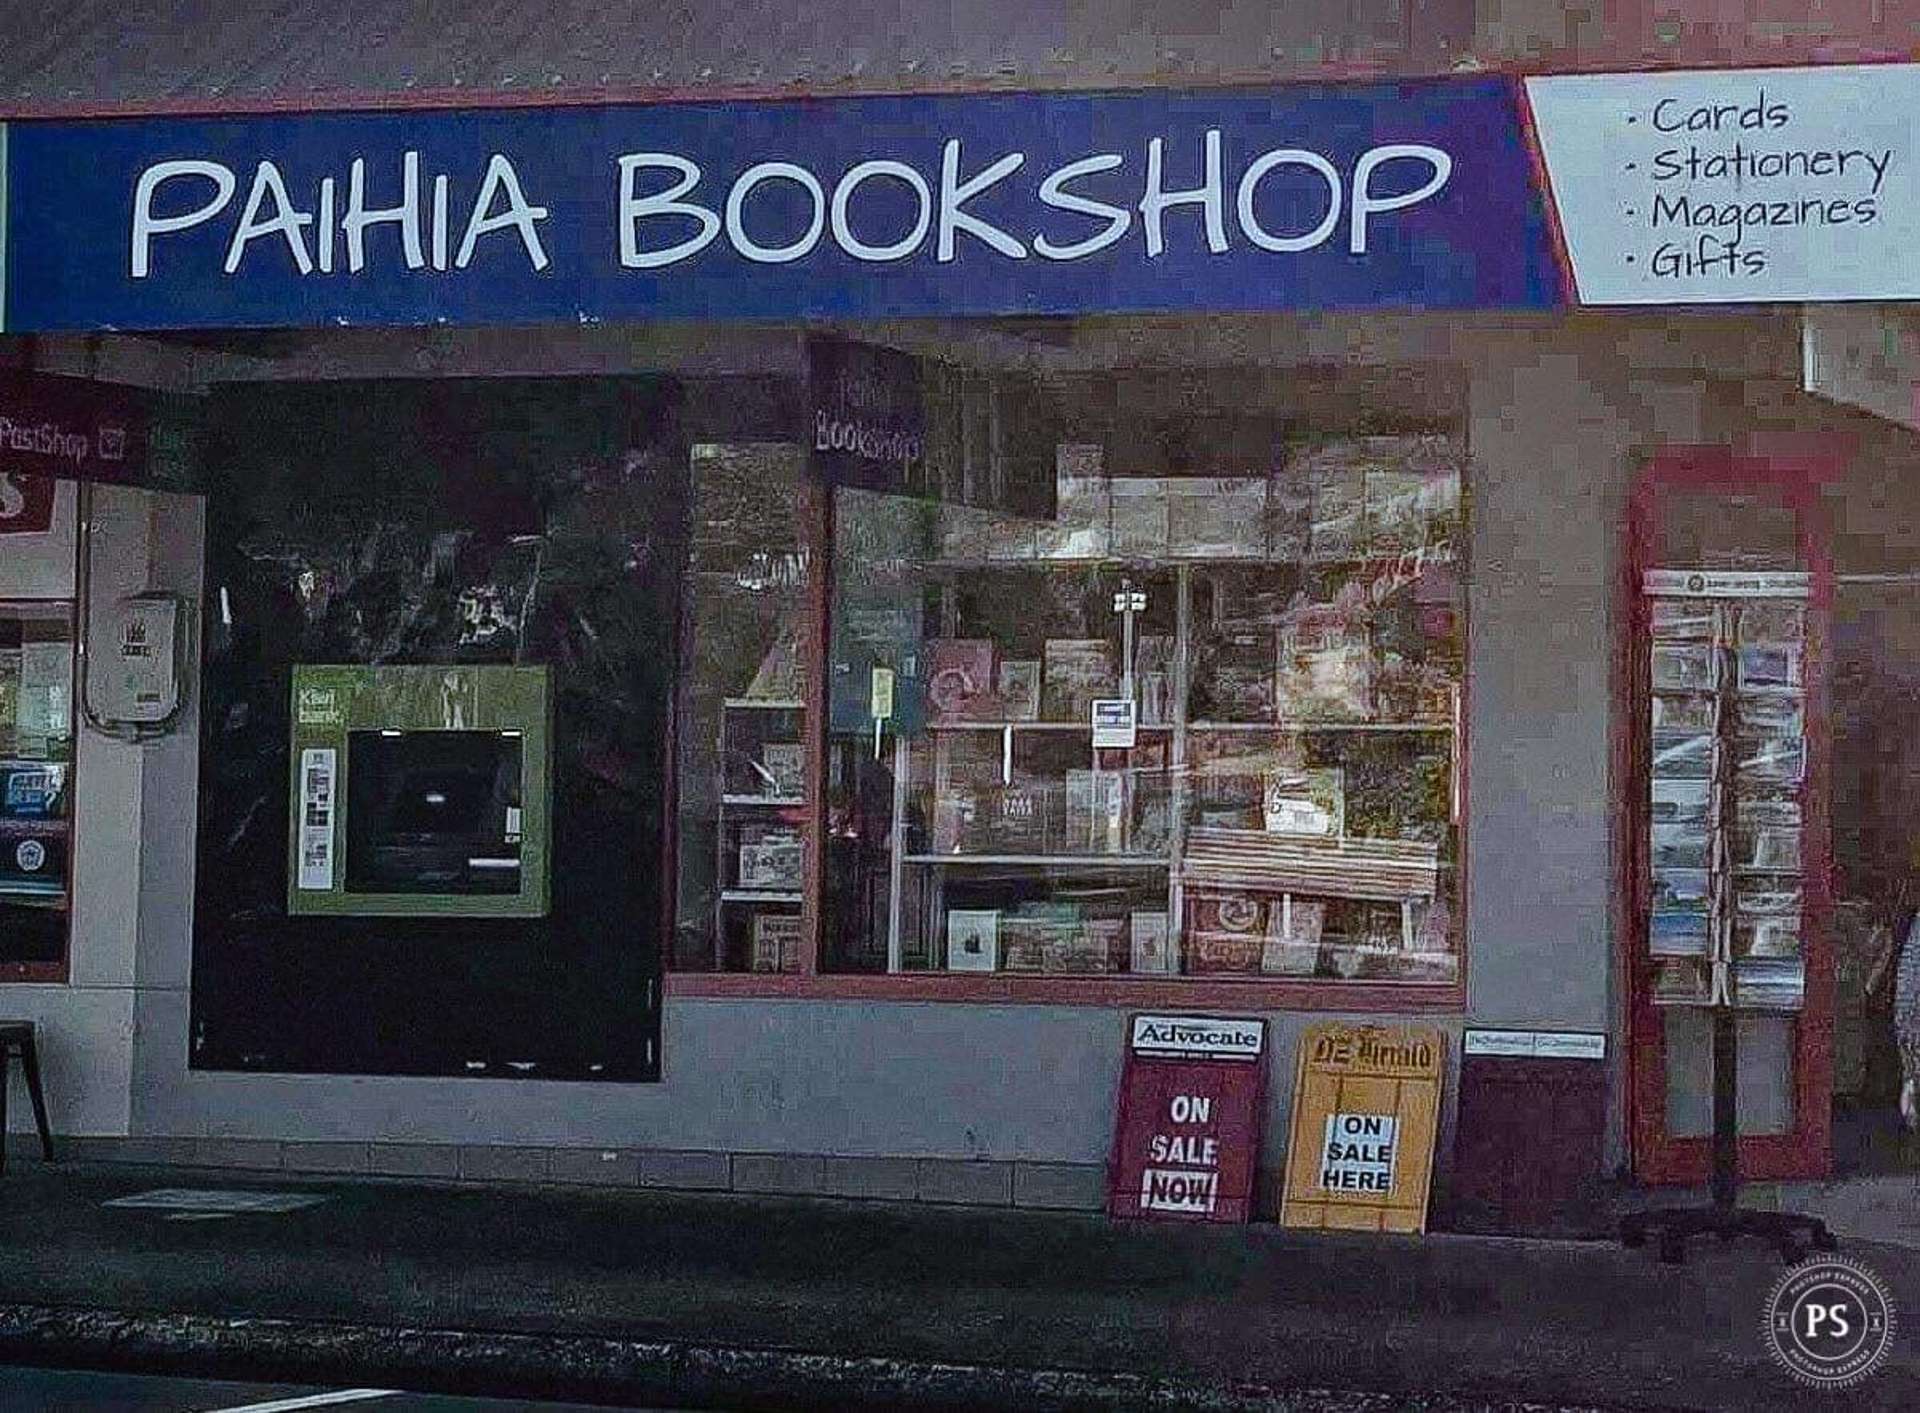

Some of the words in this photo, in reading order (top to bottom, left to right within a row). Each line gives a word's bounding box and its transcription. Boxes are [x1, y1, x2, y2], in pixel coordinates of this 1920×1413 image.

[1653, 88, 1788, 132] Cards
[1652, 142, 1891, 194] Stationery
[133, 152, 547, 276] PAIHIA
[619, 130, 1451, 267] BOOKSHOP
[1653, 194, 1876, 247] Magazines
[1652, 235, 1766, 278] Gifts
[1137, 1024, 1258, 1047] Advocate
[1171, 1096, 1210, 1124] ON
[1344, 1117, 1381, 1135] ON
[1151, 1135, 1218, 1165] SALE
[1327, 1142, 1392, 1163] SALE
[1151, 1177, 1212, 1206] NOW
[1323, 1171, 1391, 1190] HERE
